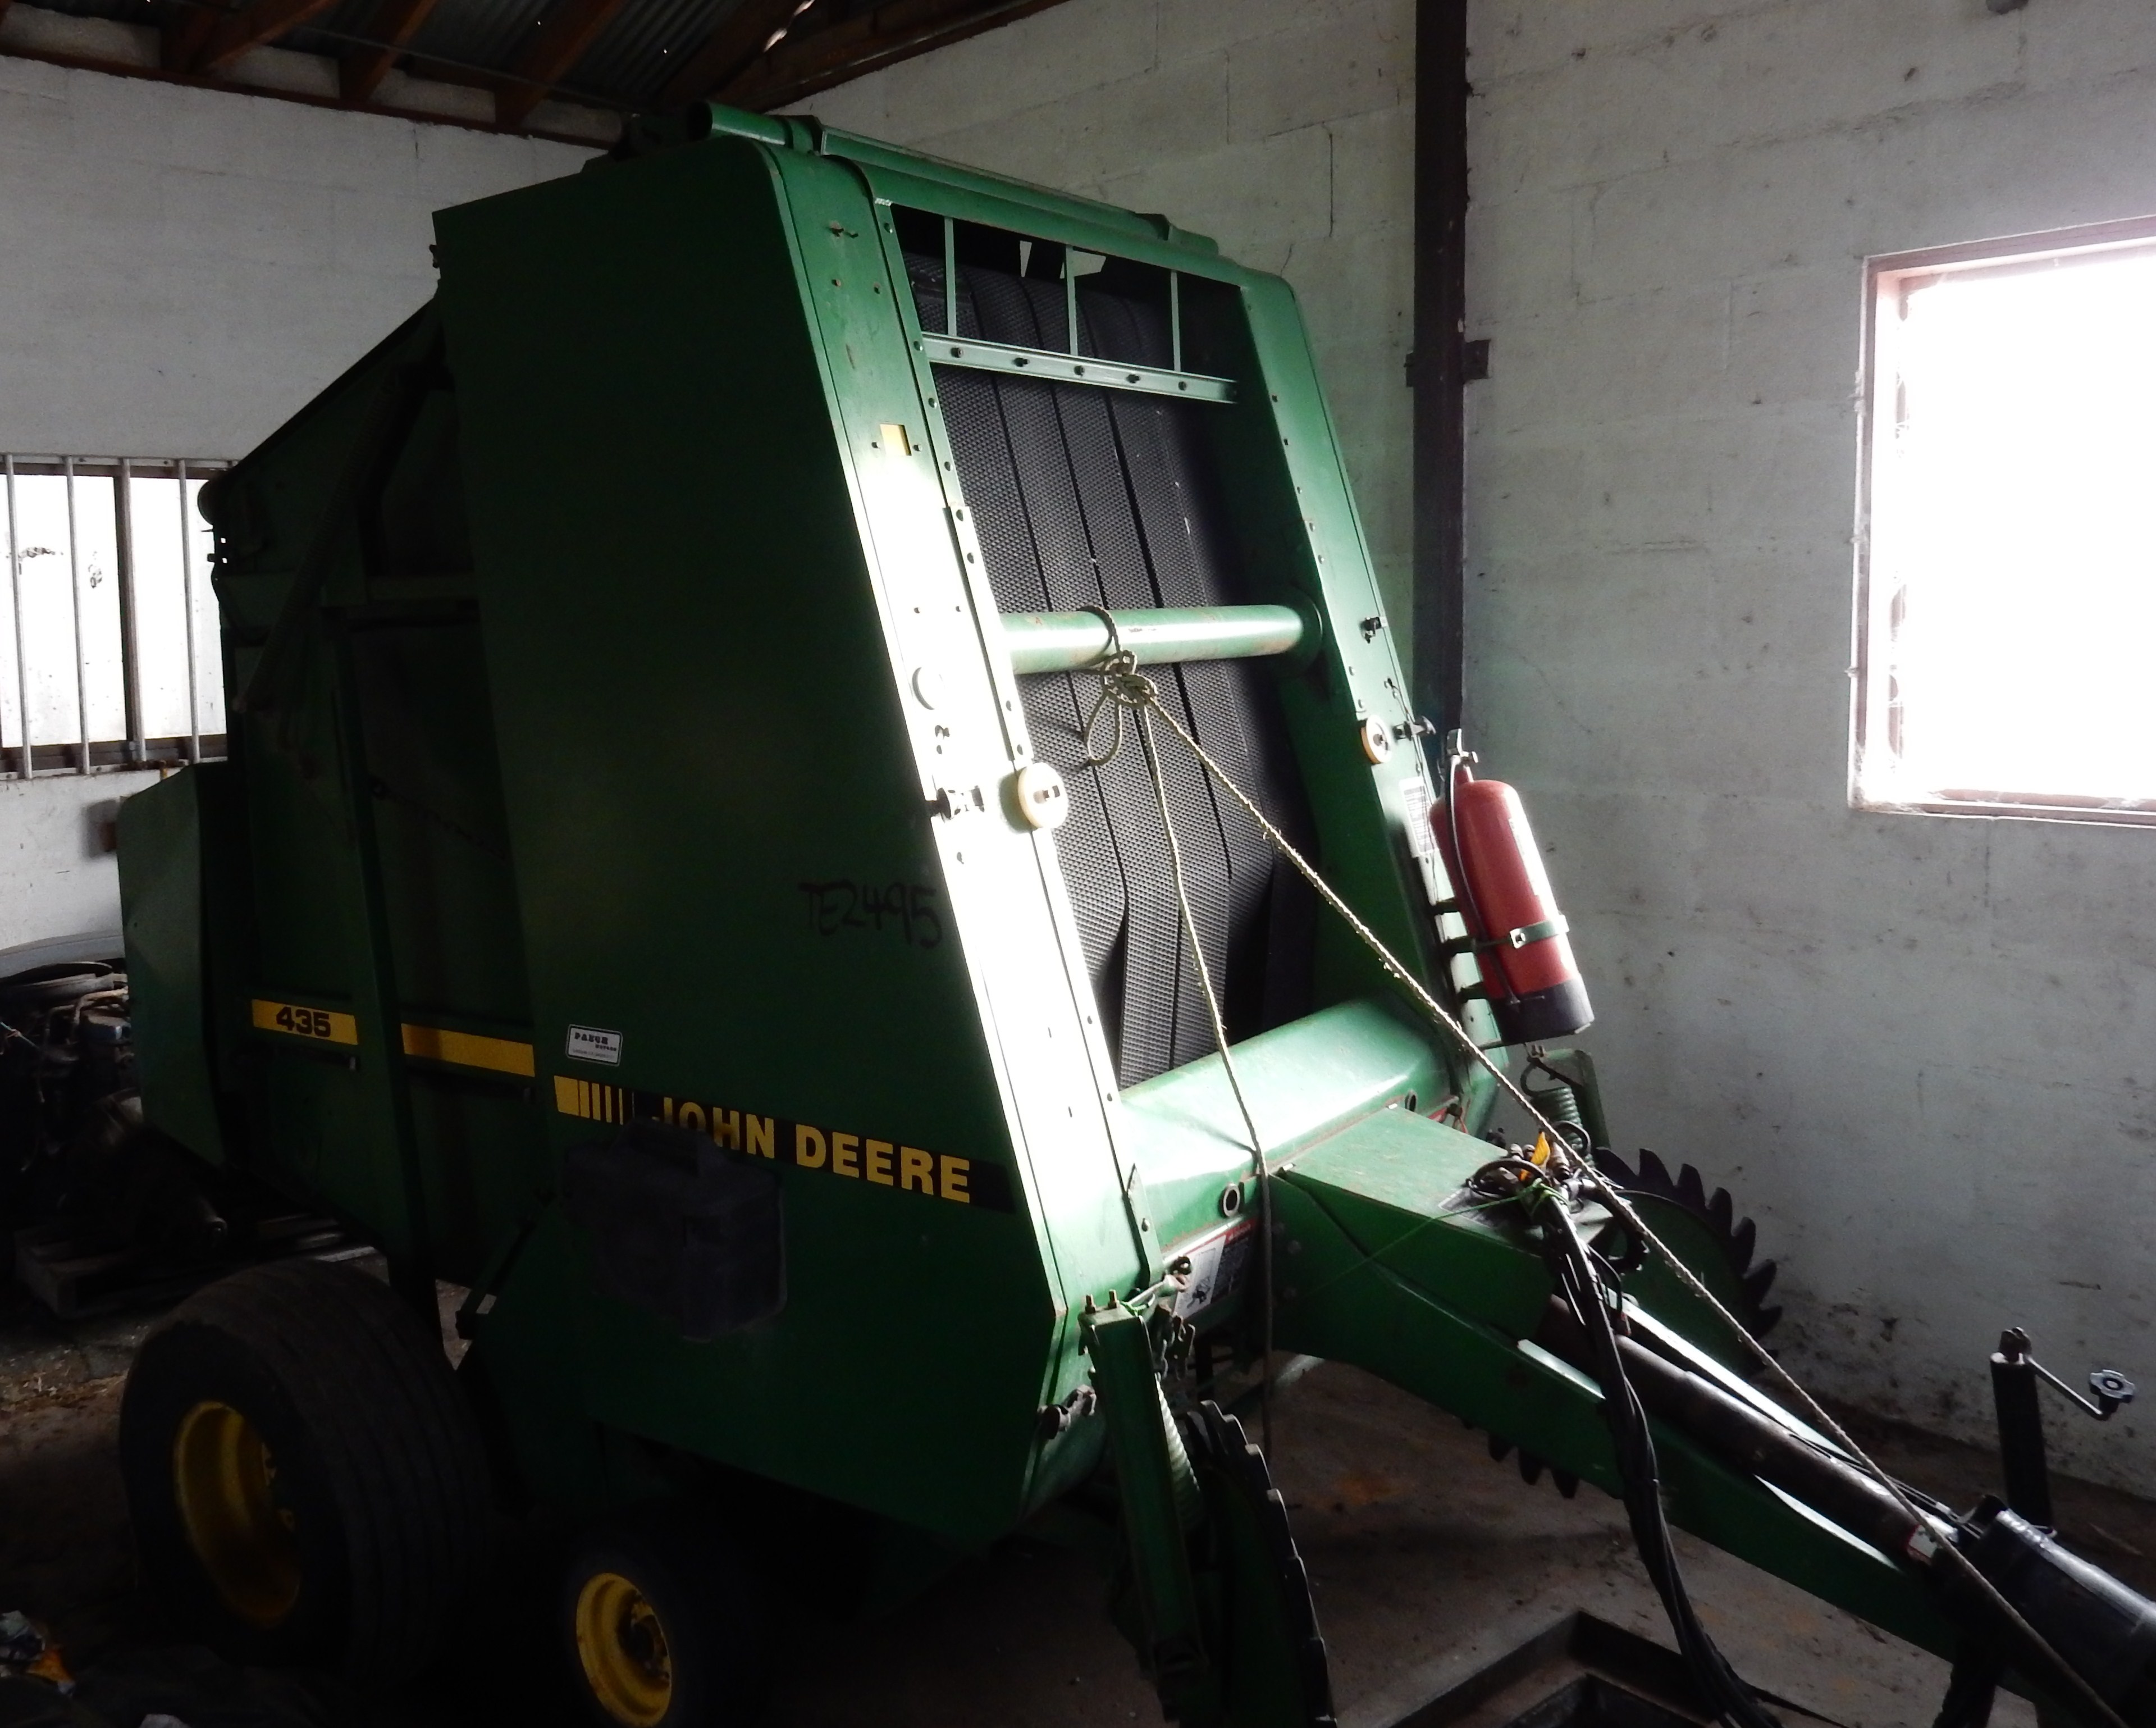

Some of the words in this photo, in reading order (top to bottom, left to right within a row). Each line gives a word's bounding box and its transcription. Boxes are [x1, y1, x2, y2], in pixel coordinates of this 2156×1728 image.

[276, 1006, 331, 1037] 435
[651, 1096, 775, 1159] JOHN
[795, 1123, 971, 1203] DEERE
